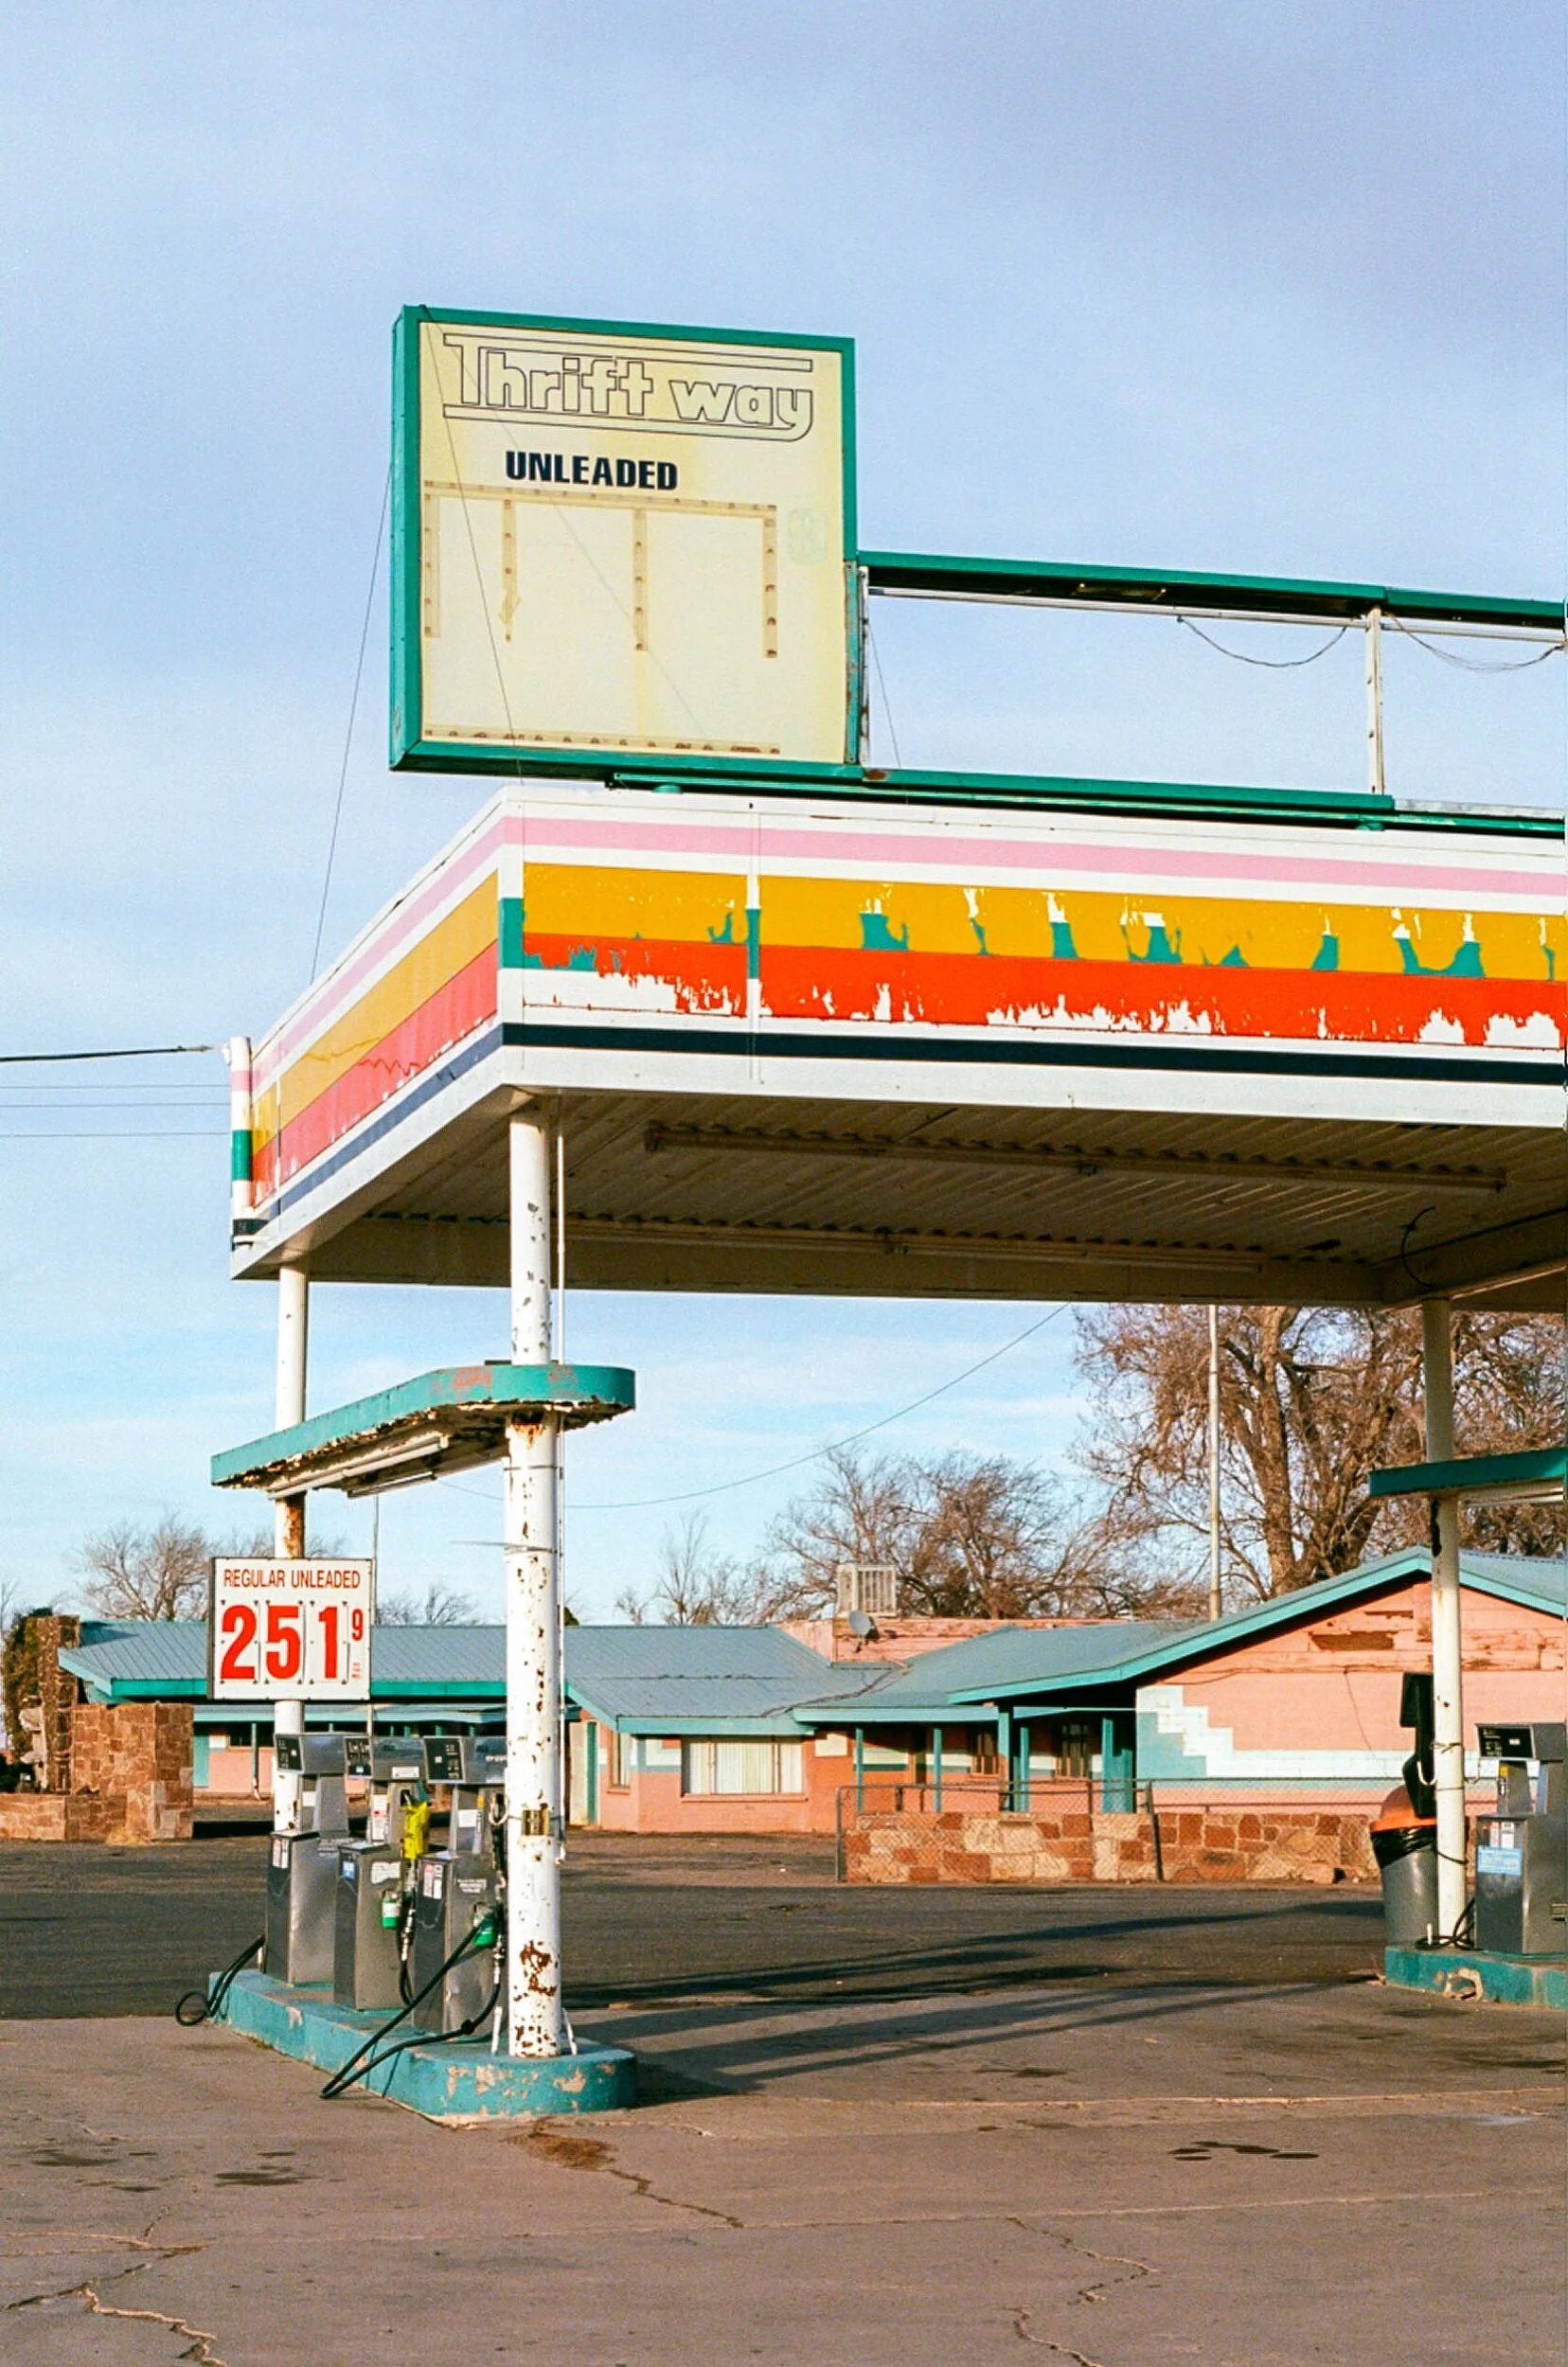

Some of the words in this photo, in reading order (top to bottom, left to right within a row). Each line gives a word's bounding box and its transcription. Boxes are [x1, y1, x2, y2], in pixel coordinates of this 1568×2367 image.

[443, 333, 654, 417] Thrift
[668, 379, 813, 442] way
[506, 450, 678, 490] UNLEADED
[223, 1569, 285, 1588] REGULAR
[291, 1570, 361, 1589] UNLEADED
